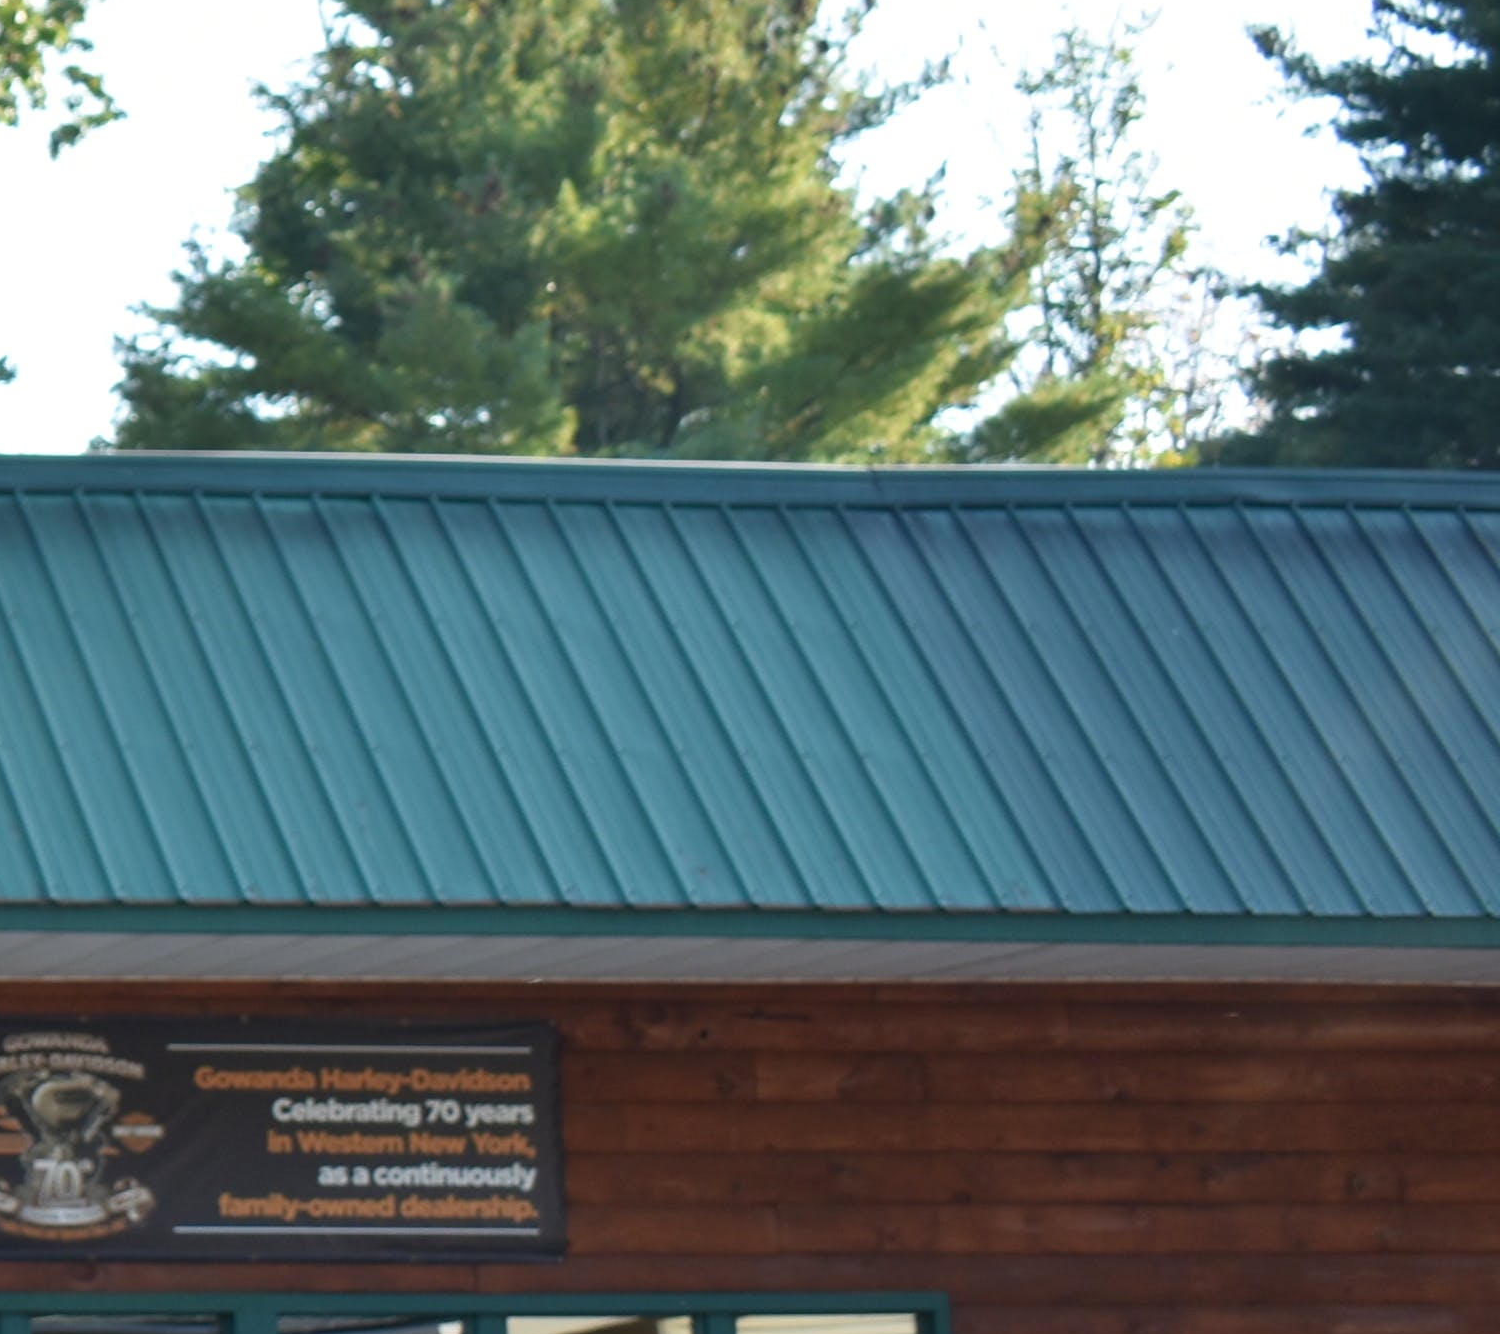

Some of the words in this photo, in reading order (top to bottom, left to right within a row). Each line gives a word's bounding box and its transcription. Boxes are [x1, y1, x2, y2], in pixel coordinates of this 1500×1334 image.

[195, 1067, 316, 1090] Gowanda
[321, 1068, 531, 1095] Harley-Davidson
[272, 1097, 421, 1126] Celebrating
[425, 1099, 460, 1122] 70
[464, 1103, 534, 1127] years
[267, 1130, 292, 1154] in
[297, 1131, 404, 1154] Western
[409, 1132, 467, 1155] New
[472, 1132, 537, 1158] York,
[318, 1166, 348, 1186] as
[352, 1167, 370, 1186] a
[373, 1162, 538, 1191] continuously
[219, 1192, 396, 1221] family-owned
[400, 1194, 540, 1222] dealership.
